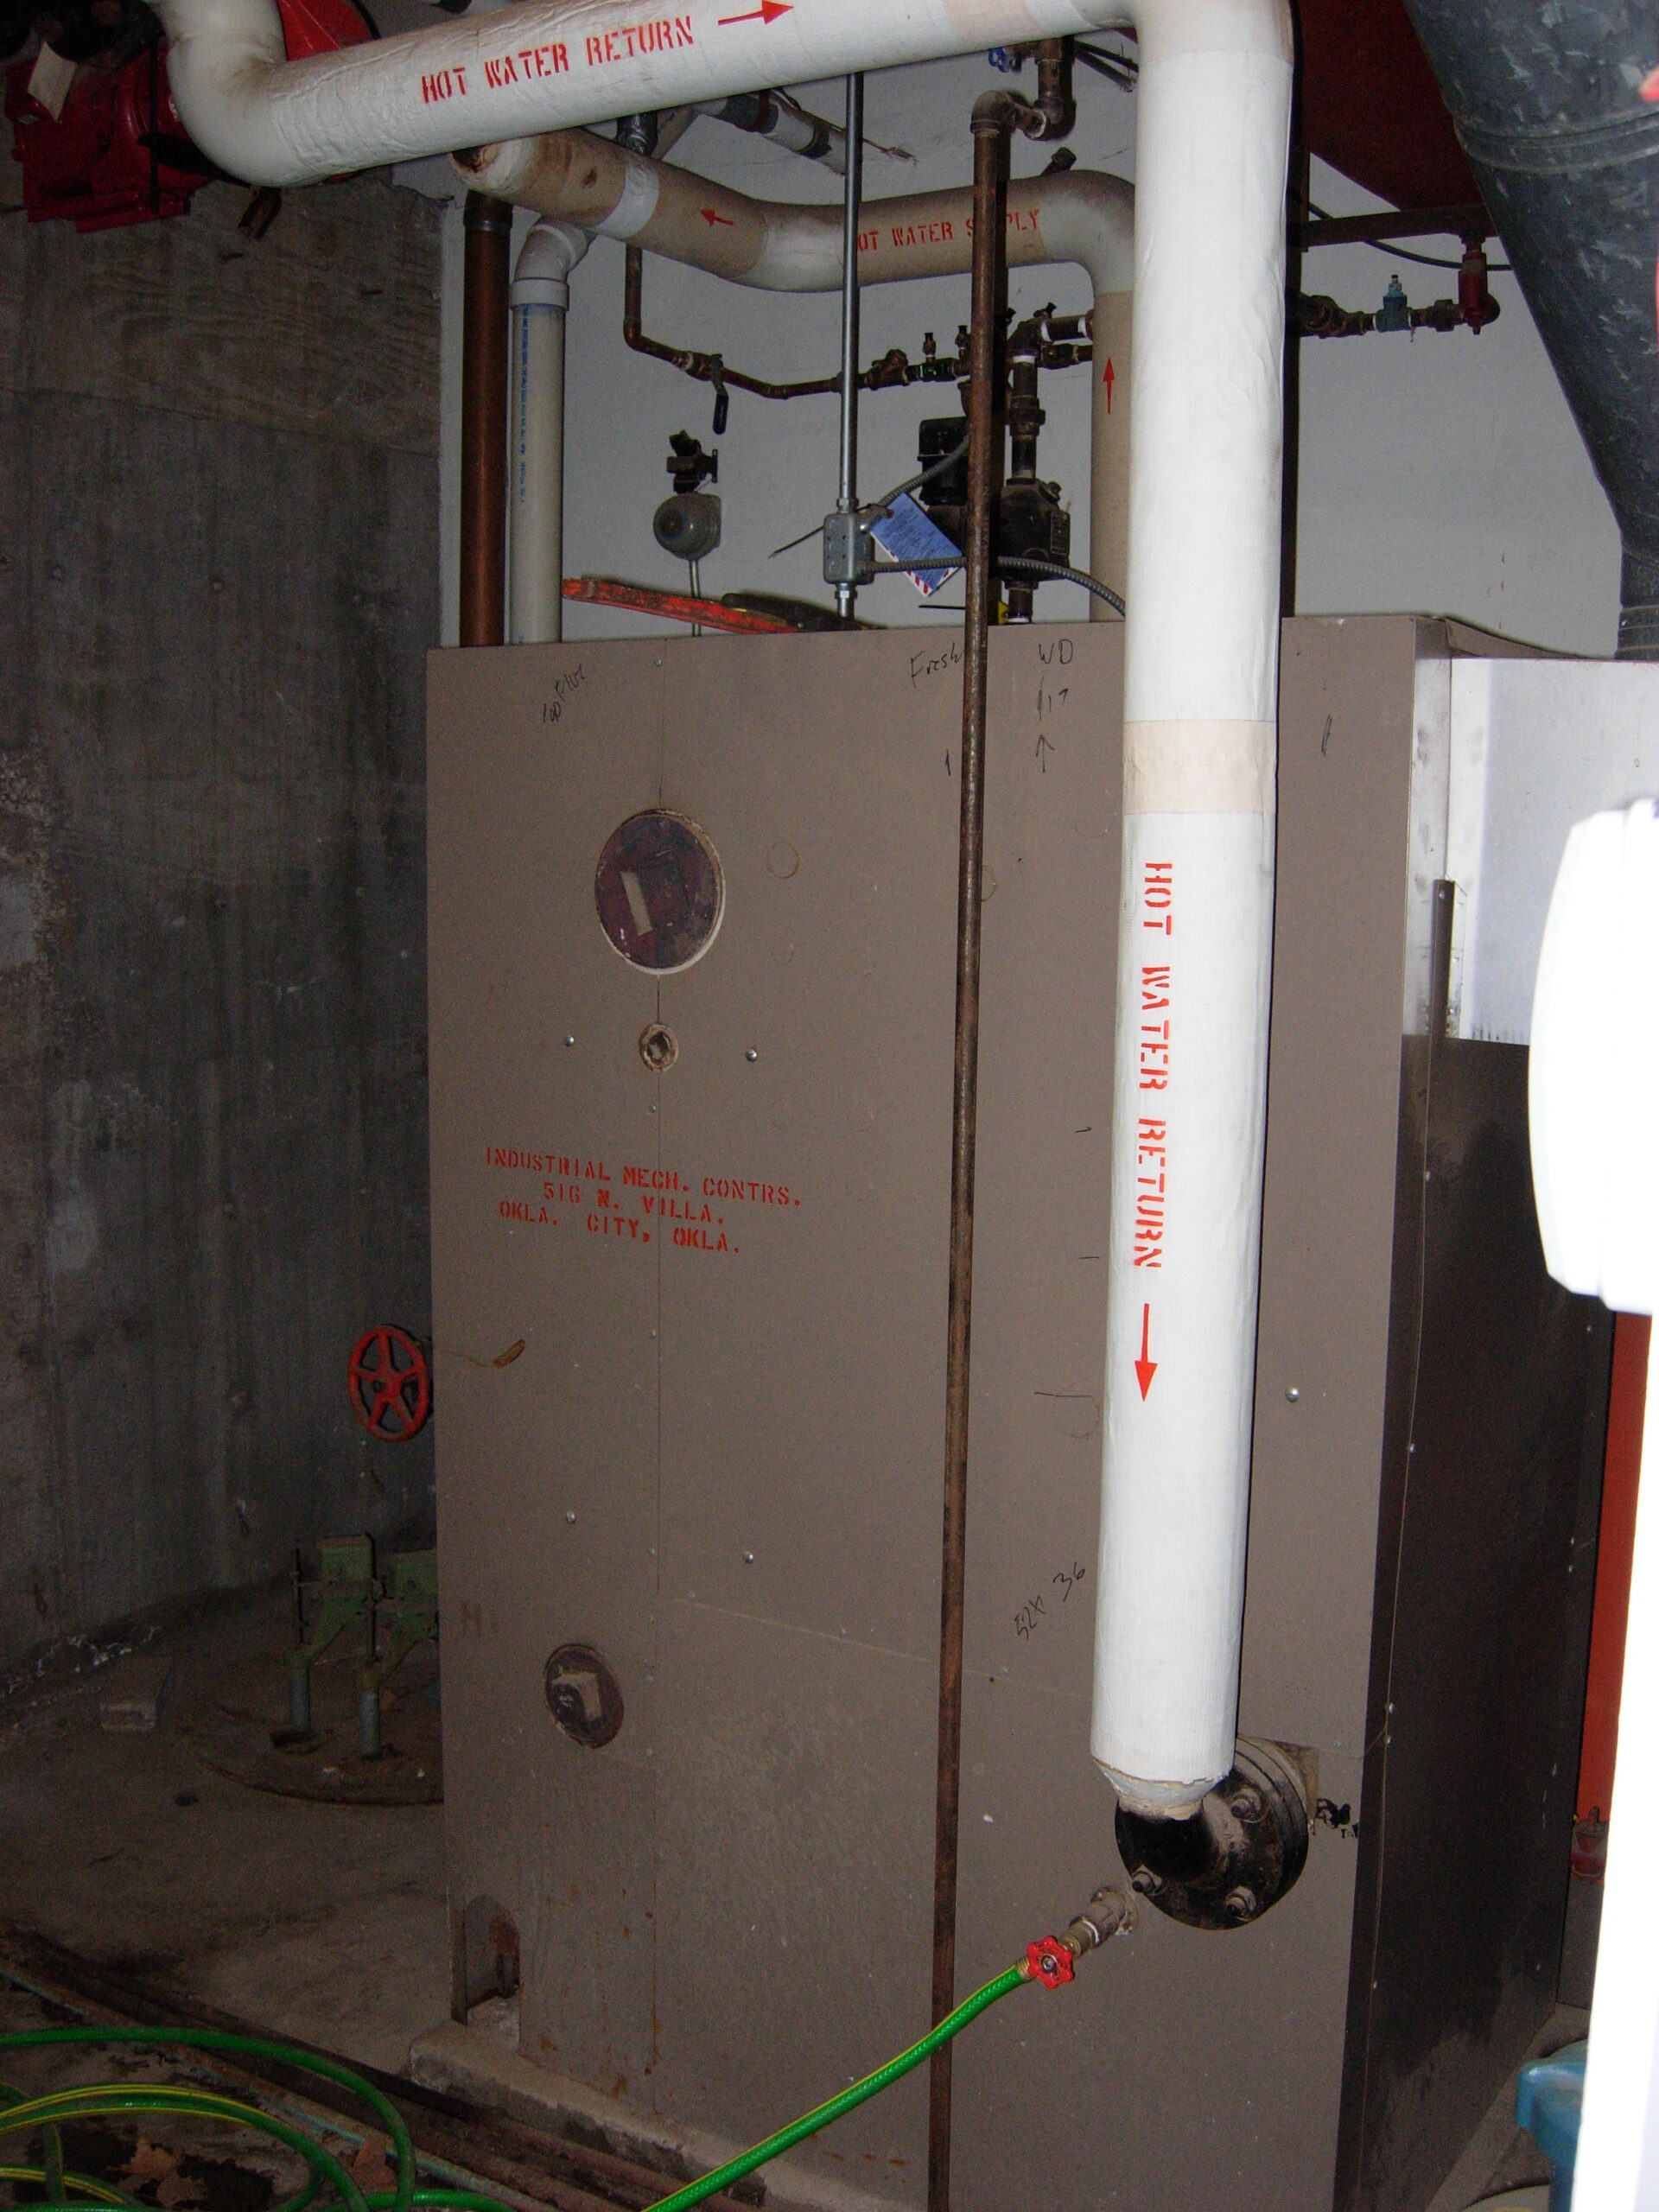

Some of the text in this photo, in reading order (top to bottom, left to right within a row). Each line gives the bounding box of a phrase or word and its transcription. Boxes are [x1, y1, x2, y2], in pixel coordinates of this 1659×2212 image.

[421, 15, 694, 103] HOT WATER RETURN
[857, 209, 1039, 251] OT WATER SPLY
[1133, 861, 1173, 1268] HOT WATER RETURN
[486, 1147, 801, 1208] INDUSTRIAL MECH. CONTRS.
[499, 1200, 740, 1255] OKLA. CITY, OKLA.
[642, 1195, 725, 1225] VILLA.
